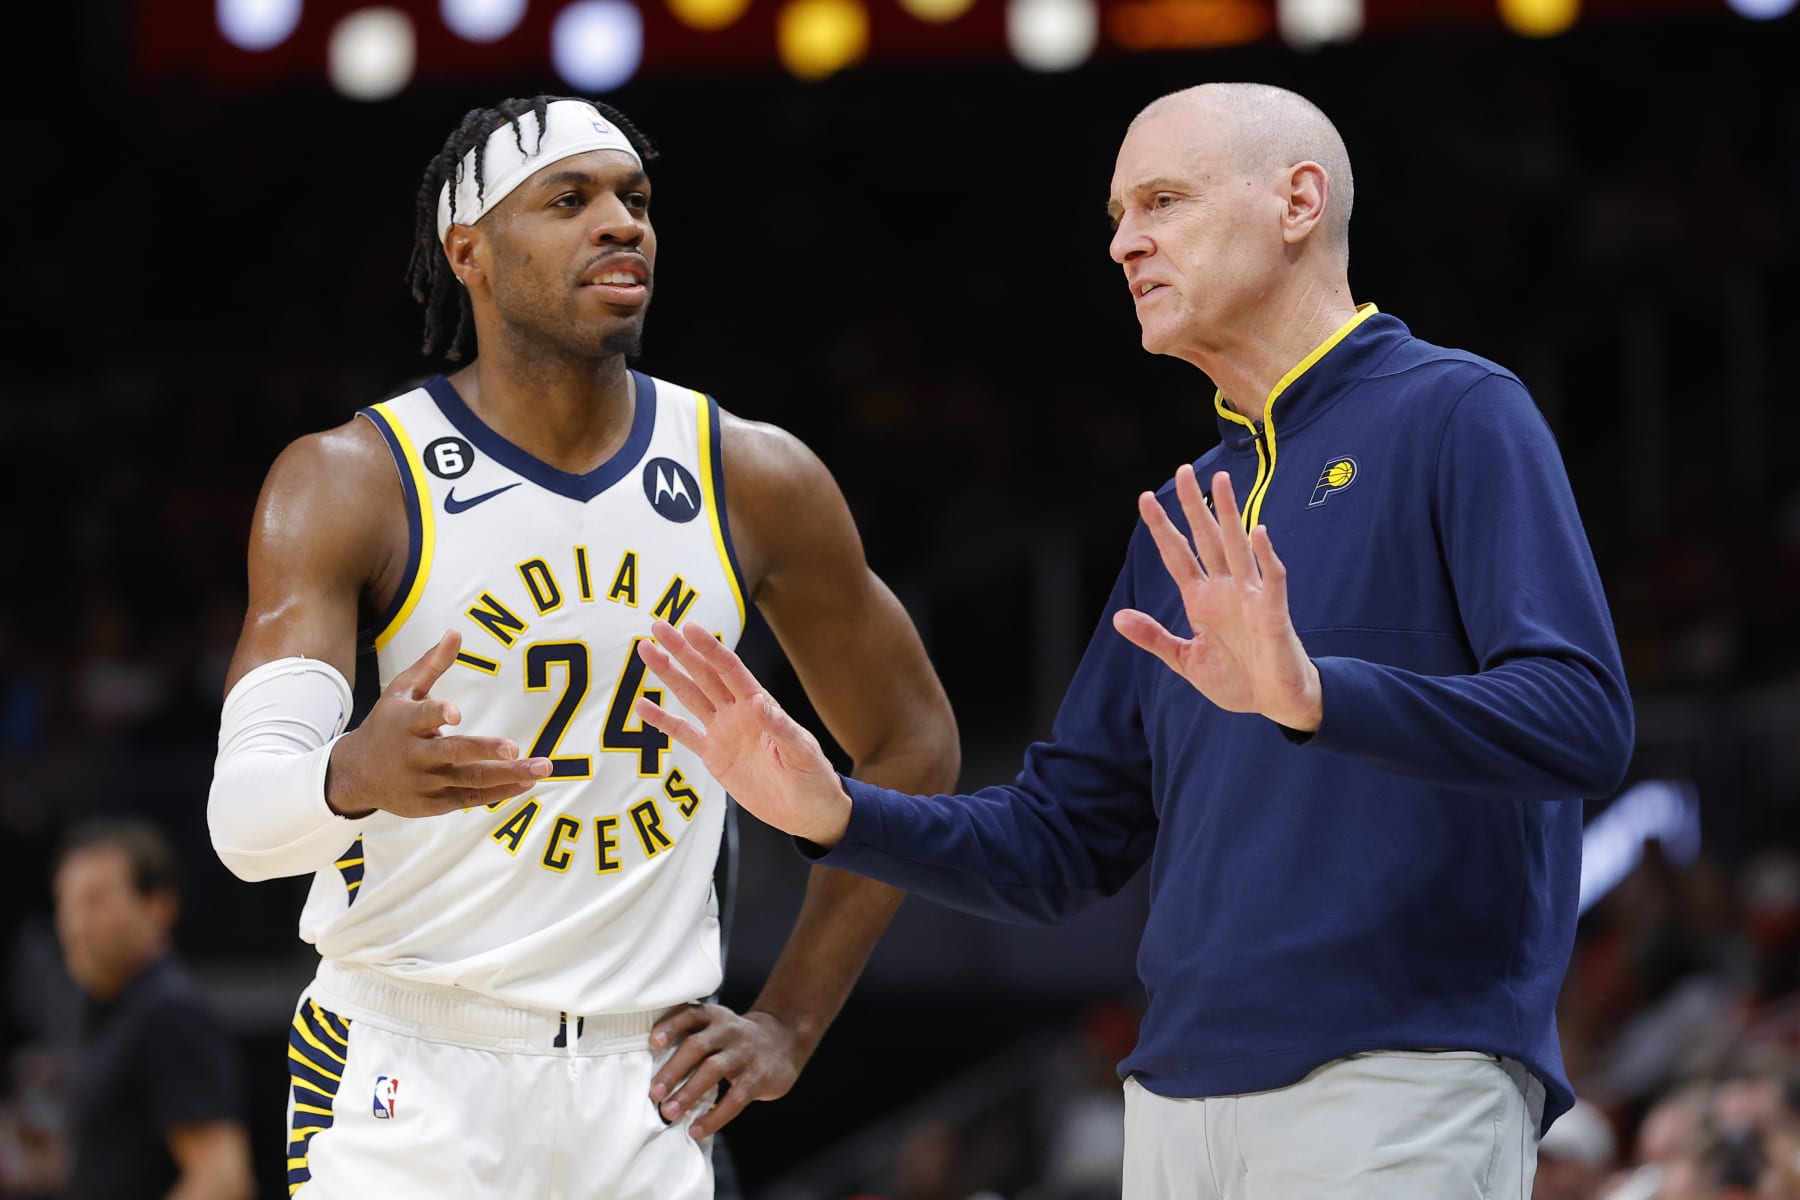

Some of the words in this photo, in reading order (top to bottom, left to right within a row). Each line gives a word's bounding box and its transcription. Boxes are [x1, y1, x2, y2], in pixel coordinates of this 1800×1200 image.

[434, 442, 464, 475] 6
[455, 545, 722, 676] INDIAN
[523, 636, 672, 780] 24
[463, 766, 701, 875] ACERS
